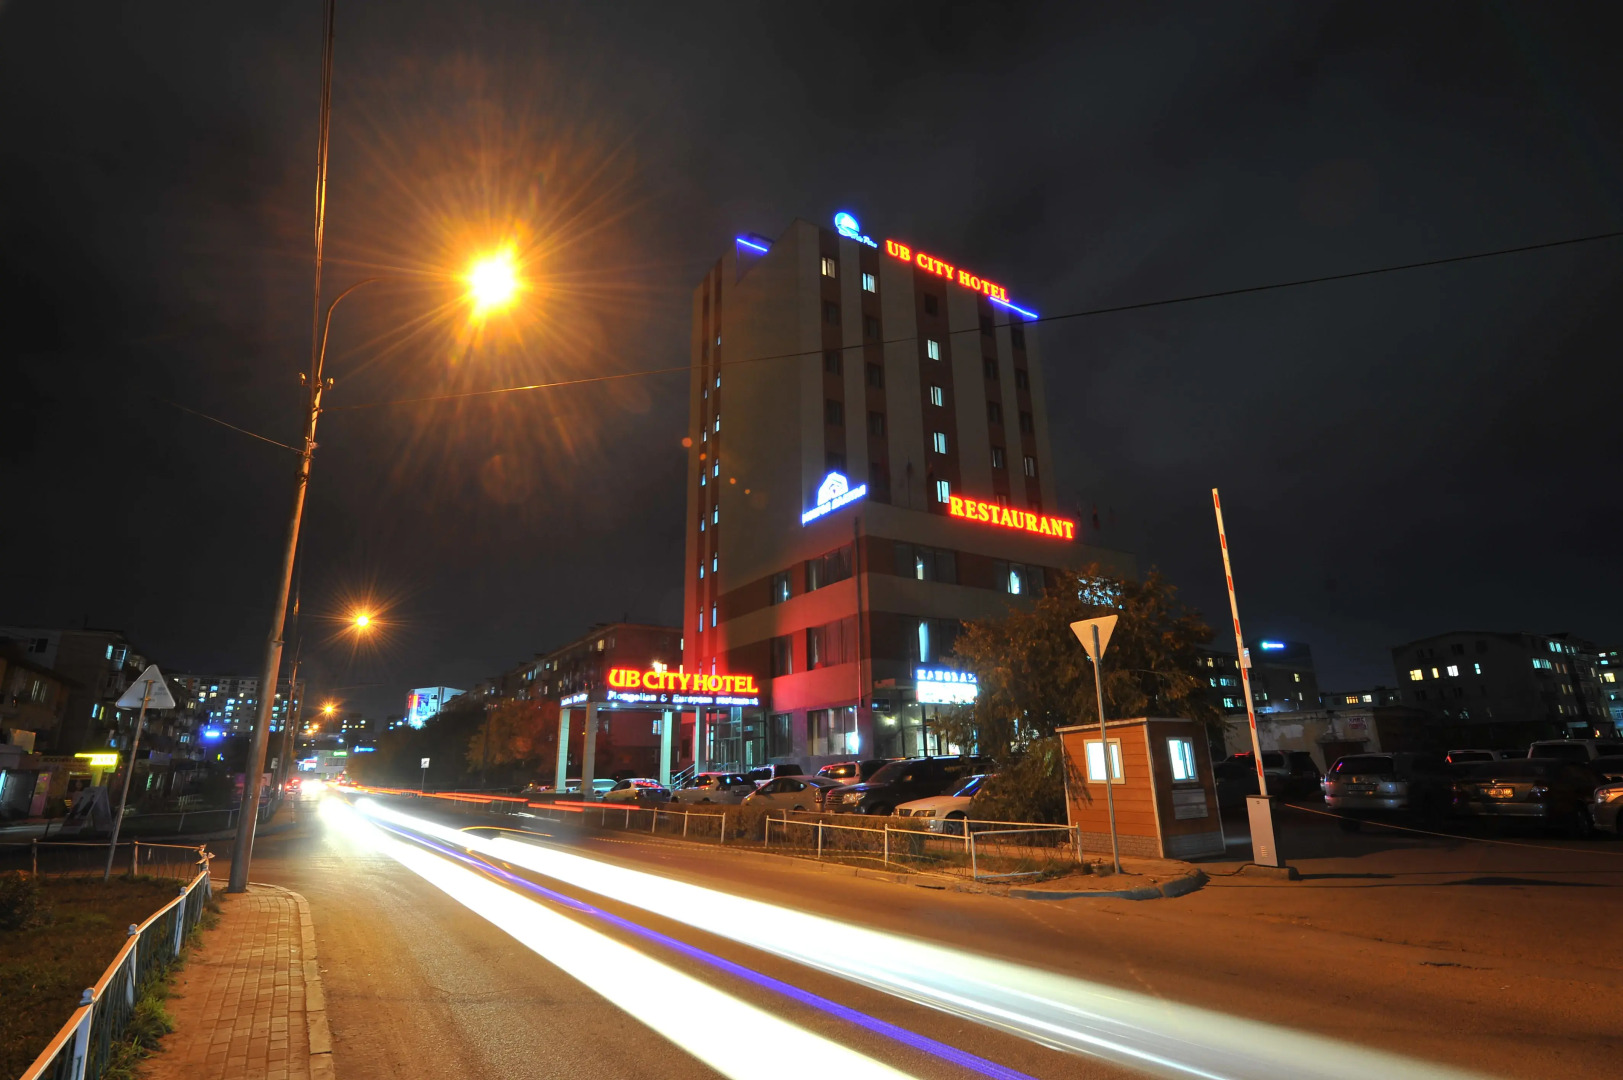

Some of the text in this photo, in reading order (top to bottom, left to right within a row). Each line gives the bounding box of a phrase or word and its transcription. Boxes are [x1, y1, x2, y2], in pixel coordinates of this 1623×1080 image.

[885, 239, 1010, 303] UB CITY HOTEL
[948, 495, 1075, 539] RESTAURANT
[606, 690, 657, 703] Mongolian
[660, 693, 668, 702] &
[671, 694, 713, 705] European
[608, 668, 759, 693] UB CITY HOTEL
